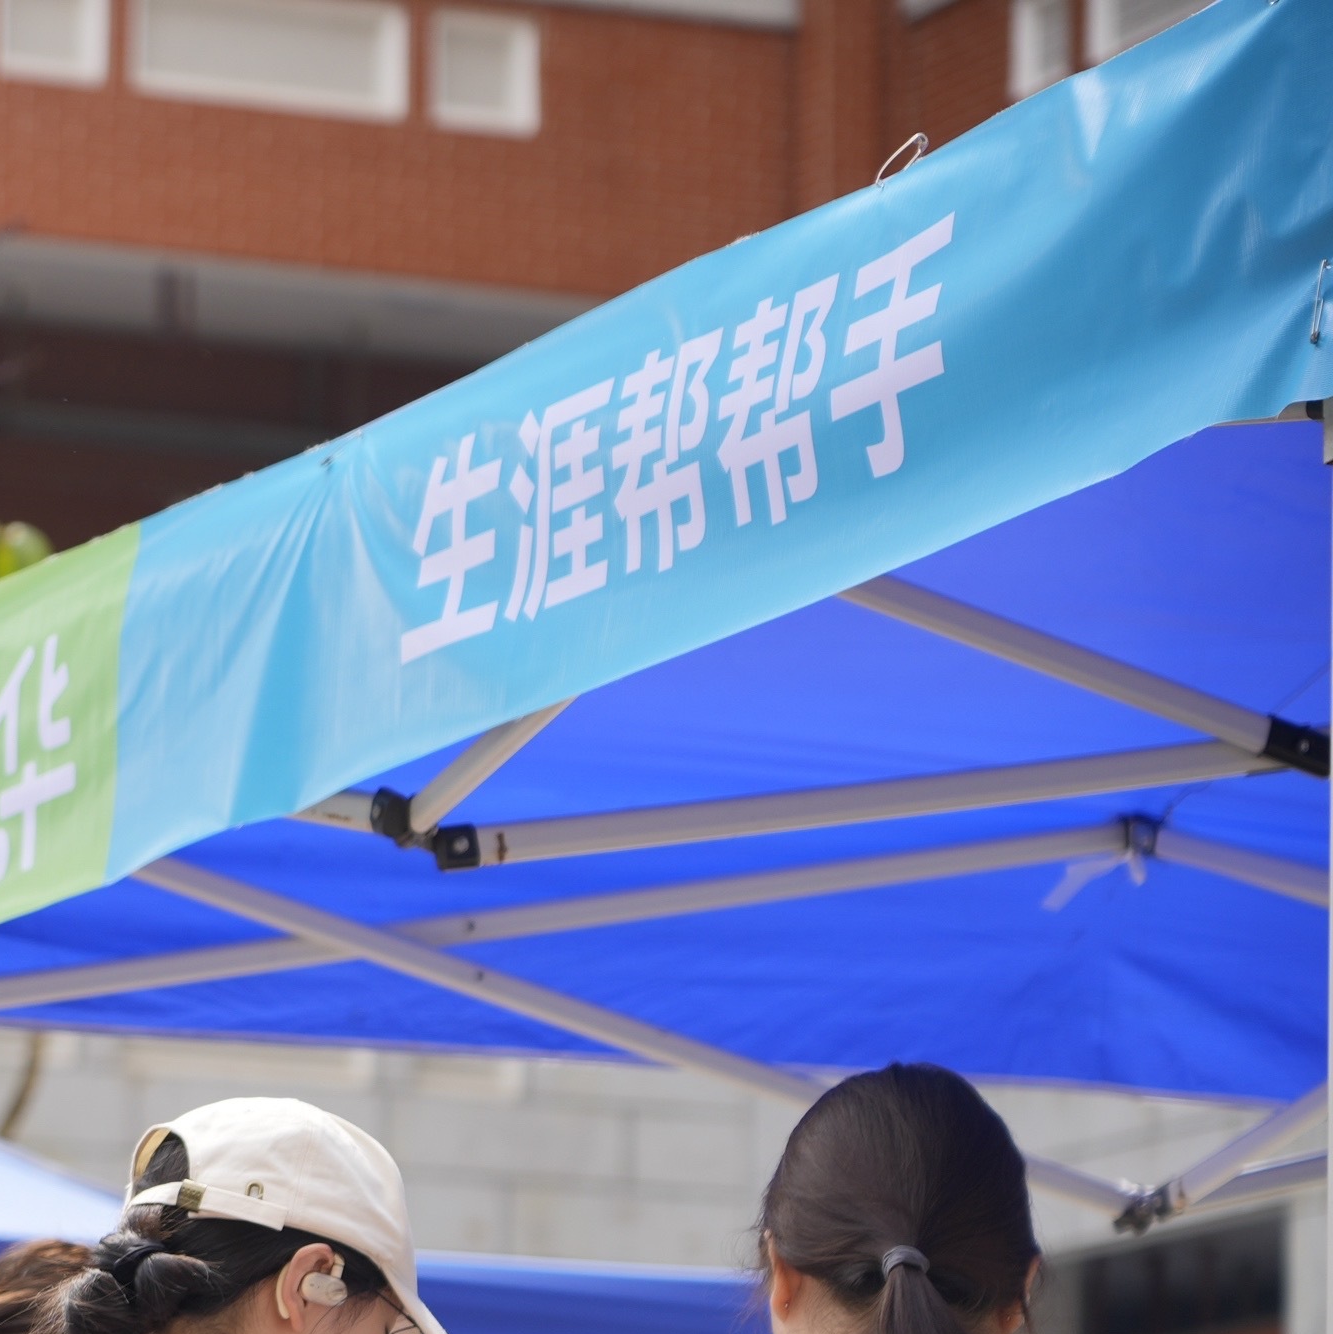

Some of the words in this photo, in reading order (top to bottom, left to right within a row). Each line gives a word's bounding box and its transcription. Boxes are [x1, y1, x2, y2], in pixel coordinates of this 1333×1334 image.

[400, 211, 956, 666] 生涯帮帮手
